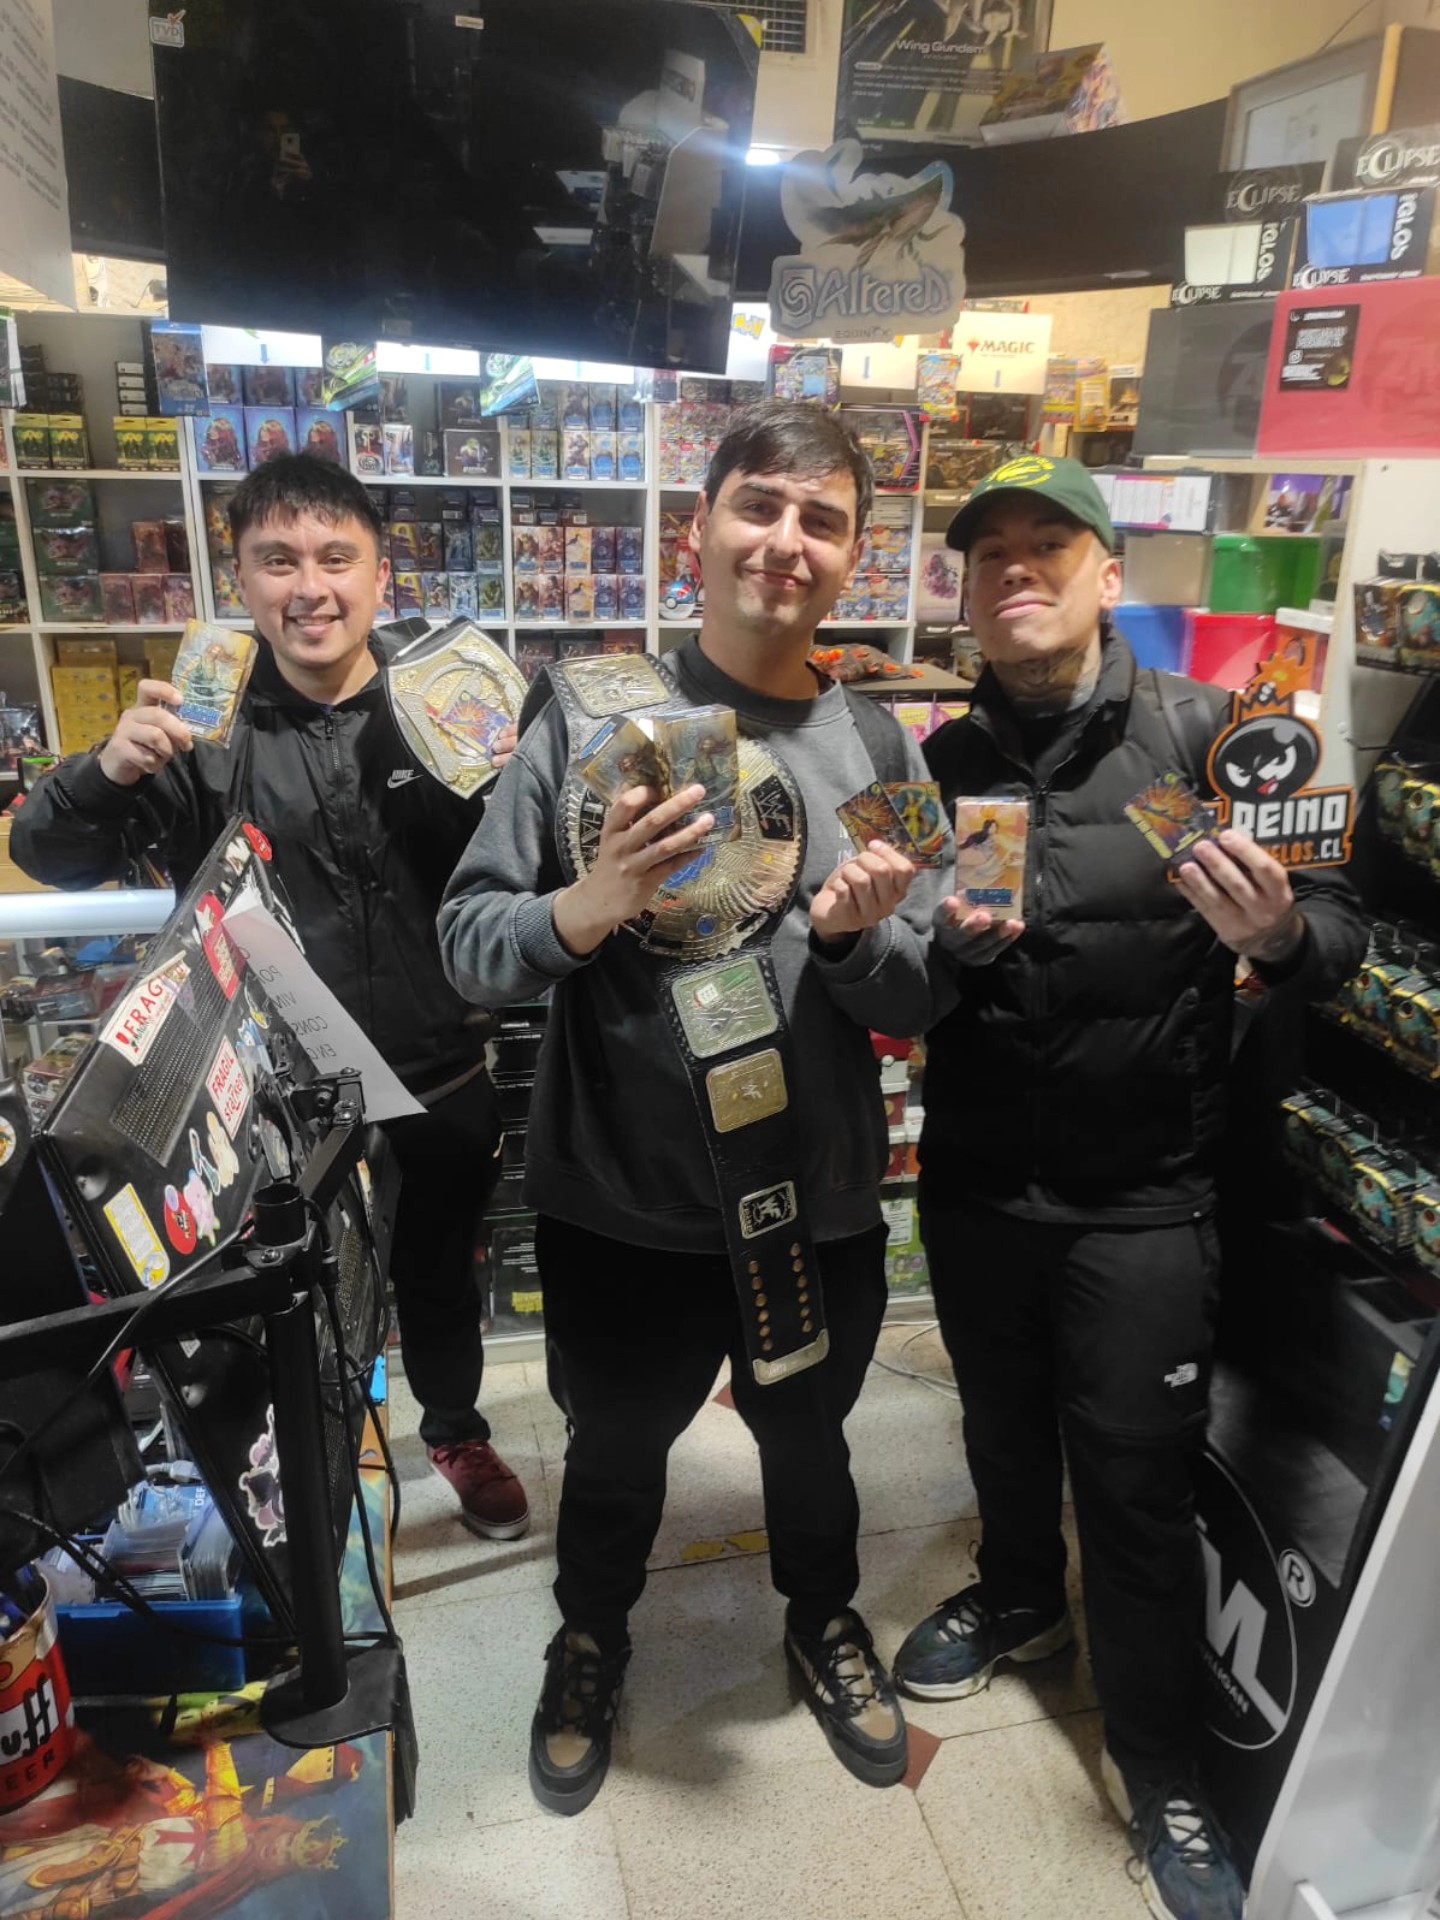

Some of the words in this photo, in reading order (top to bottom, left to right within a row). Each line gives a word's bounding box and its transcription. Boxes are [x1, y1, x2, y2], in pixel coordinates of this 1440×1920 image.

[896, 40, 930, 54] Wing
[980, 340, 1036, 354] MAGIC
[1, 1672, 52, 1757] uff
[5, 1748, 56, 1792] EER
